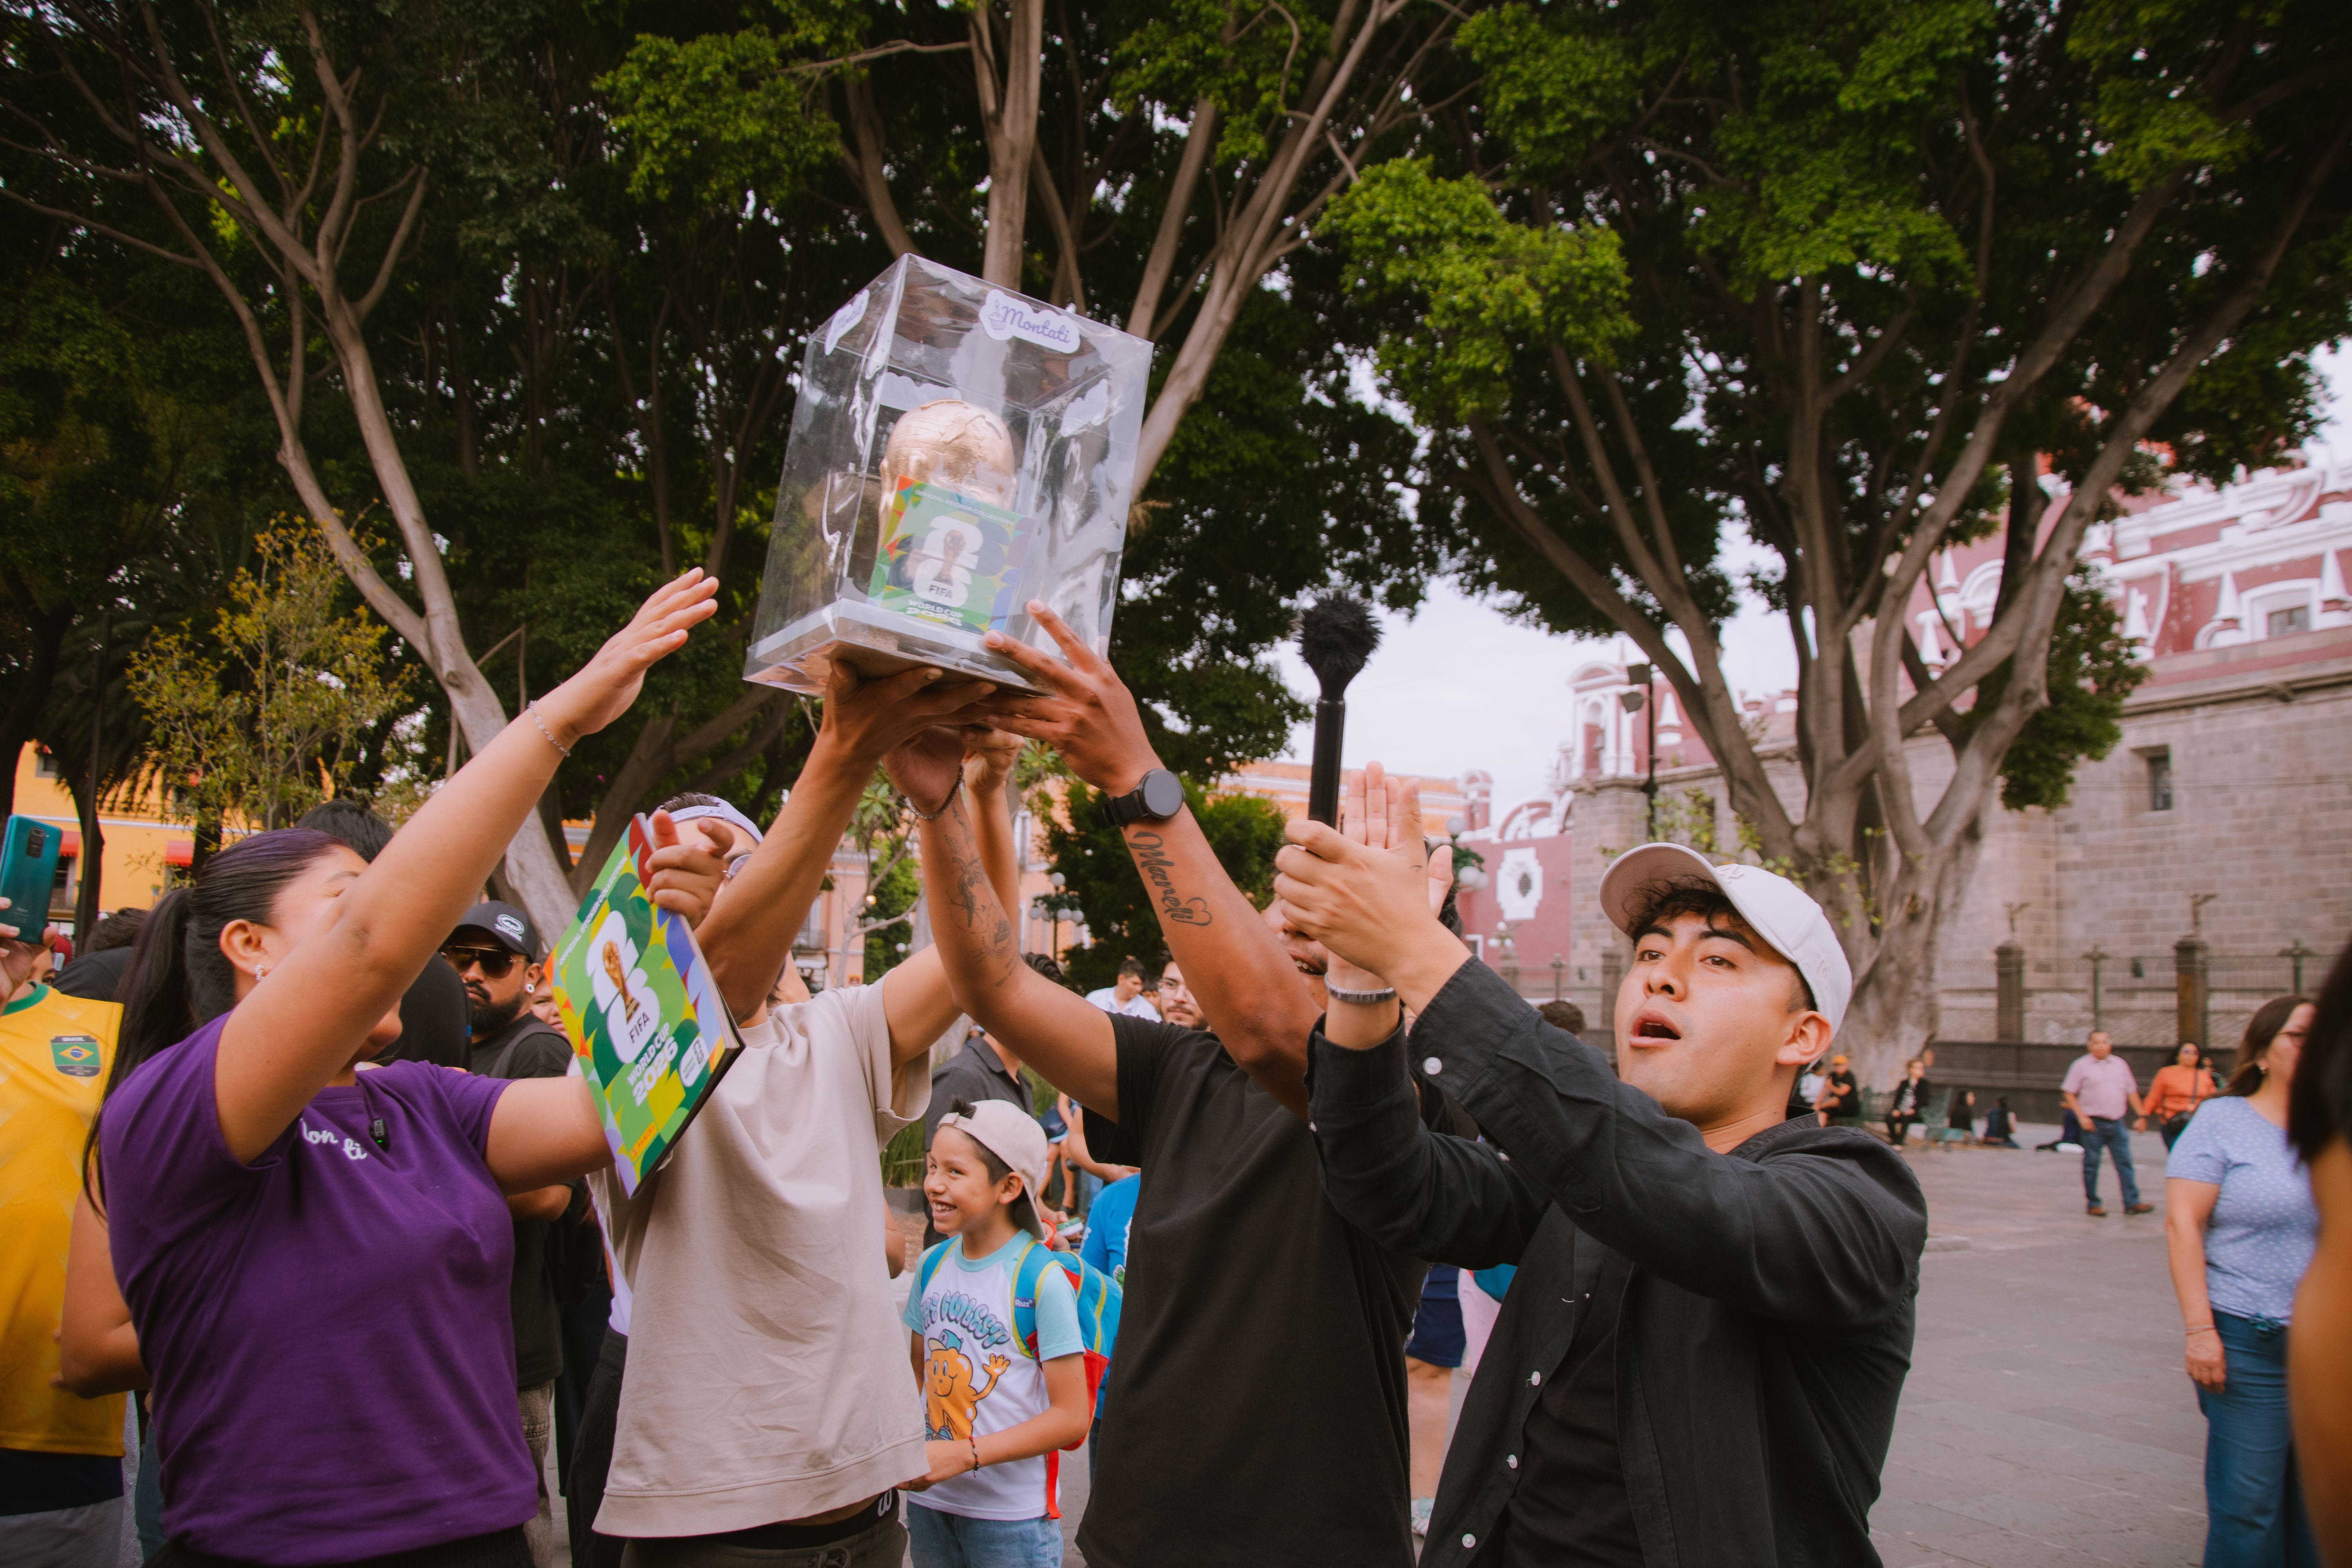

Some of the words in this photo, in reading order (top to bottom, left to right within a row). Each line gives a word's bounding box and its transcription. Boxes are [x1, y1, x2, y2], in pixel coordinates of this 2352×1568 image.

[1002, 306, 1070, 343] Montati
[946, 499, 973, 511] STICKER
[974, 509, 1013, 525] COLLECTION
[929, 584, 953, 599] FIFA
[906, 607, 962, 626] 2026
[909, 599, 943, 613] WORLD
[944, 609, 964, 618] CUP
[558, 933, 582, 965] OFFICIAL
[579, 902, 600, 934] STICKER
[597, 854, 628, 903] COLLECTION
[629, 1011, 650, 1044] FIFA
[626, 1044, 656, 1086] WORLD
[653, 1022, 670, 1049] CUP
[632, 1036, 678, 1107] 2026
[637, 1123, 655, 1148] PANINI
[940, 1290, 1011, 1349] COOLEST
